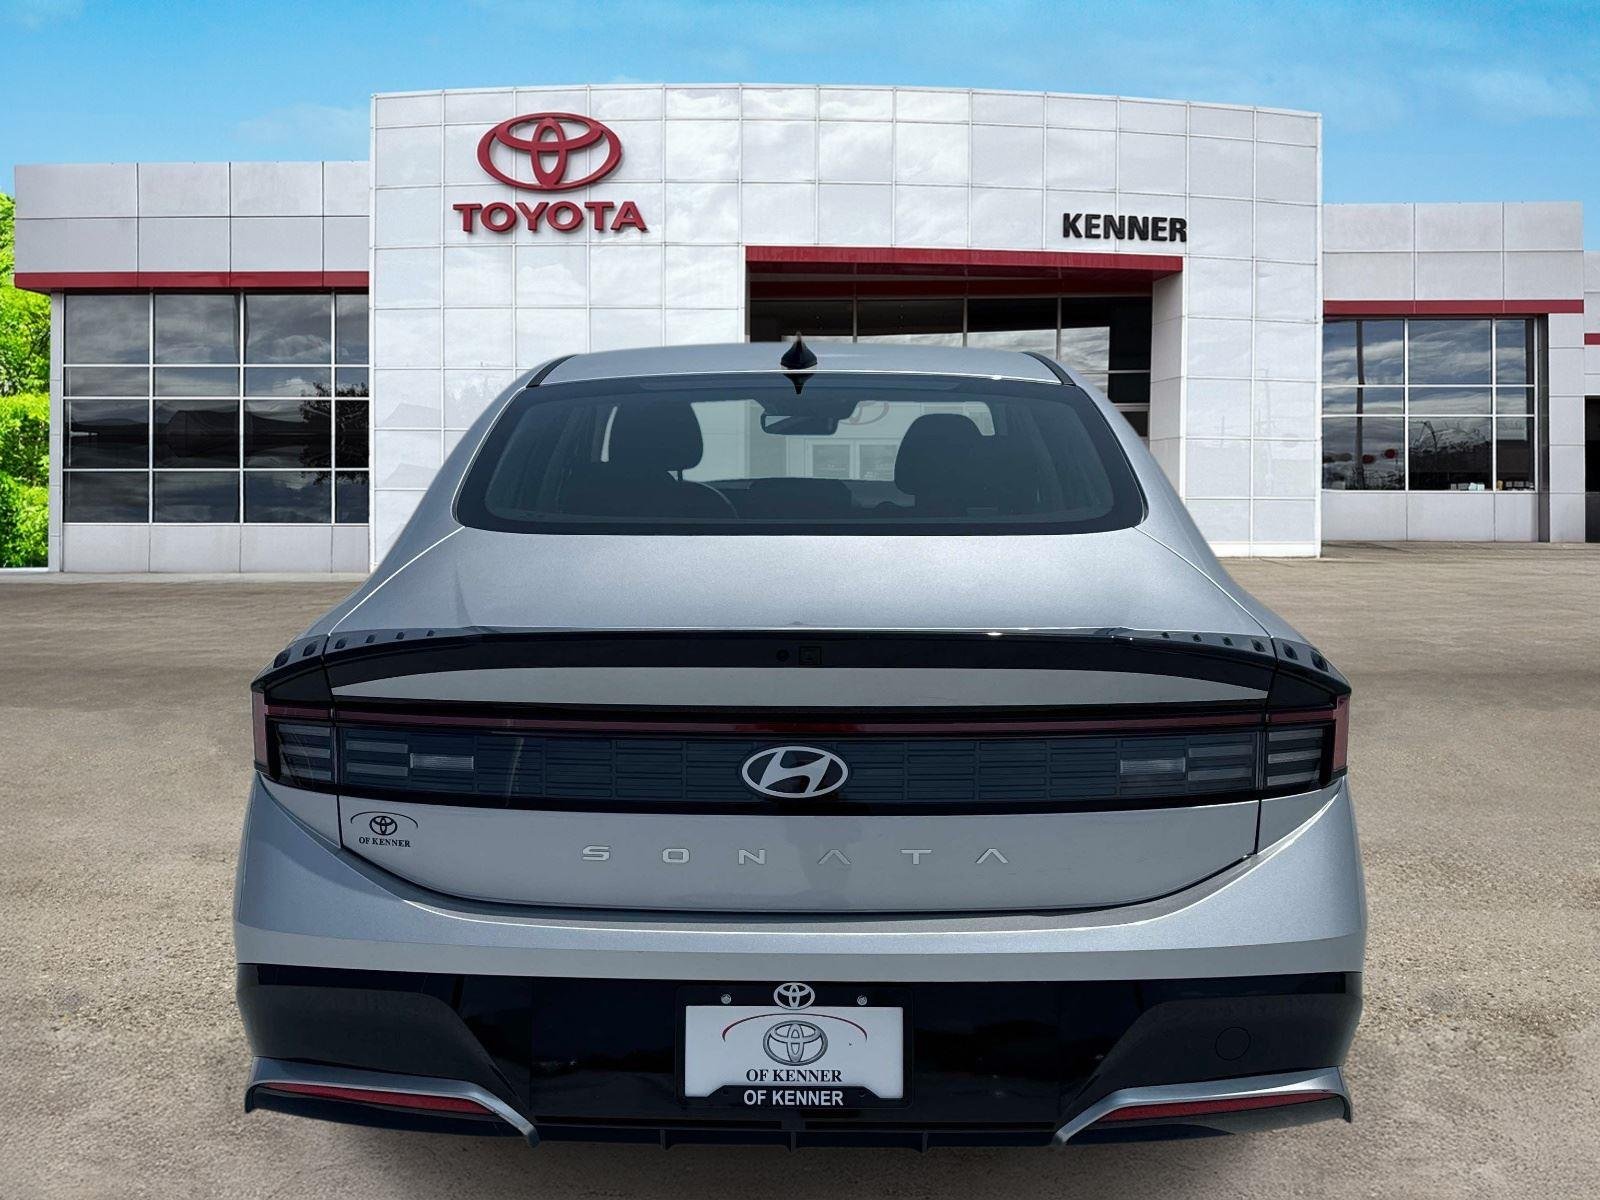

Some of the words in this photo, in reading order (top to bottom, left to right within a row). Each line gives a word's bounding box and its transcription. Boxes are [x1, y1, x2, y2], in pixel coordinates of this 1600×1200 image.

[453, 200, 648, 233] TOYOTA
[1062, 213, 1187, 243] KENNER
[359, 836, 370, 844] OF
[372, 837, 410, 847] KENNER
[581, 845, 1009, 865] SONATA
[745, 1068, 769, 1083] OF
[772, 1068, 843, 1083] KENNER
[743, 1088, 768, 1106] OF
[771, 1089, 844, 1107] KENNER
